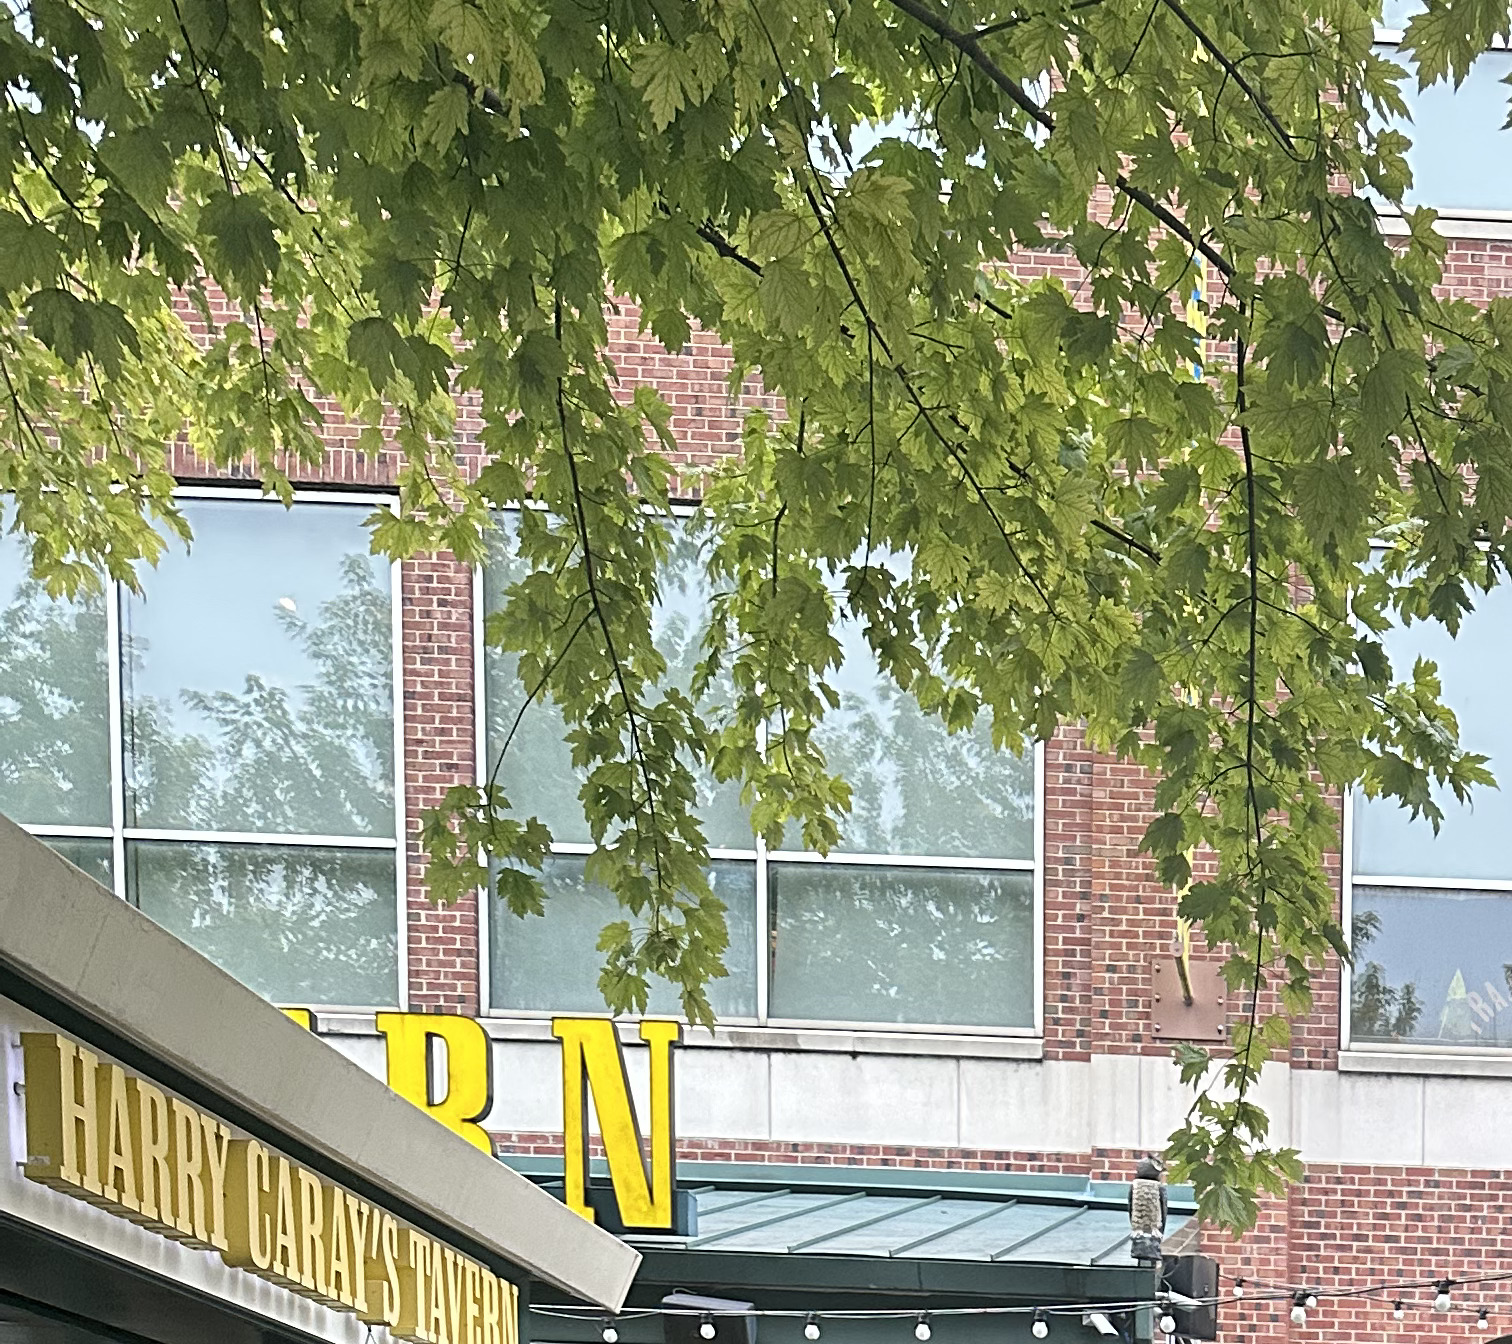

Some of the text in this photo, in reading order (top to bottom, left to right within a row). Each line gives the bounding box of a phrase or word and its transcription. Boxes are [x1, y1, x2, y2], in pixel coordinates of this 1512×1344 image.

[57, 1033, 231, 1252] HARRY
[247, 1139, 400, 1328] CARAY'S
[278, 1007, 680, 1230] RN
